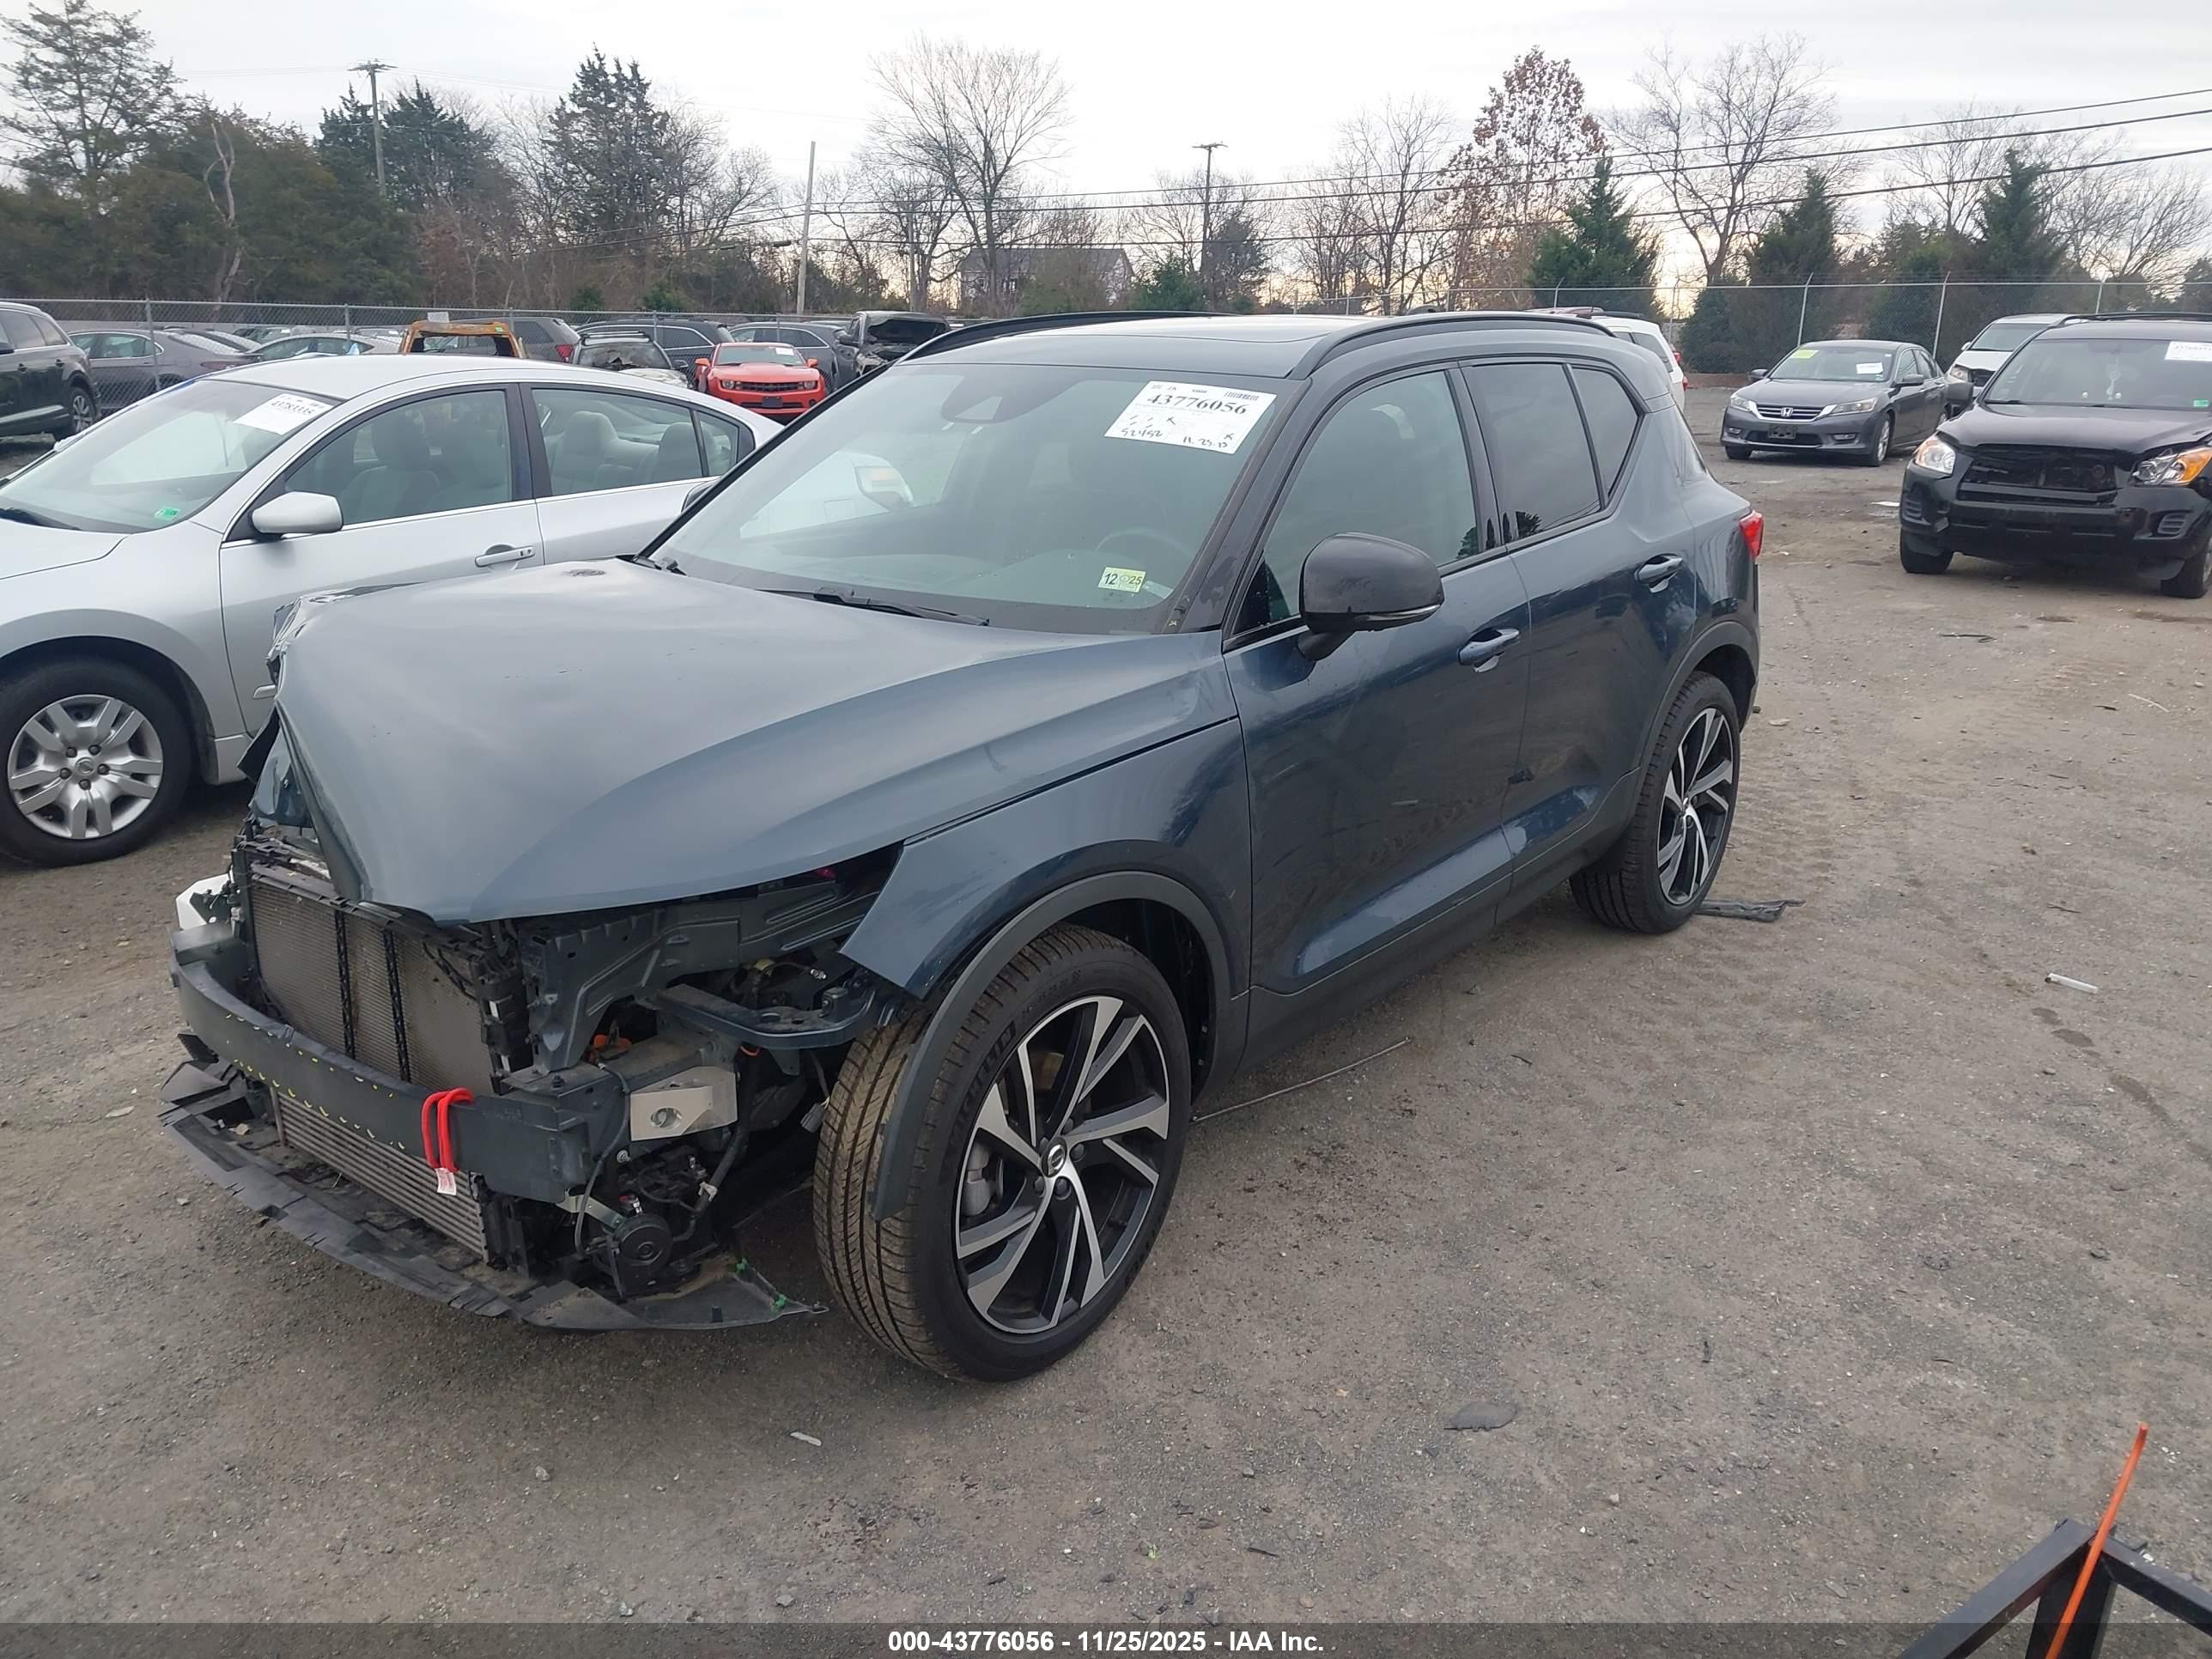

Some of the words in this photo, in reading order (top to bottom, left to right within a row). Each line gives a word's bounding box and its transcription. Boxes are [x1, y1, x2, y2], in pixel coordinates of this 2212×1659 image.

[1147, 393, 1250, 415] 43776056
[1104, 573, 1118, 585] 12
[1128, 575, 1142, 585] 25
